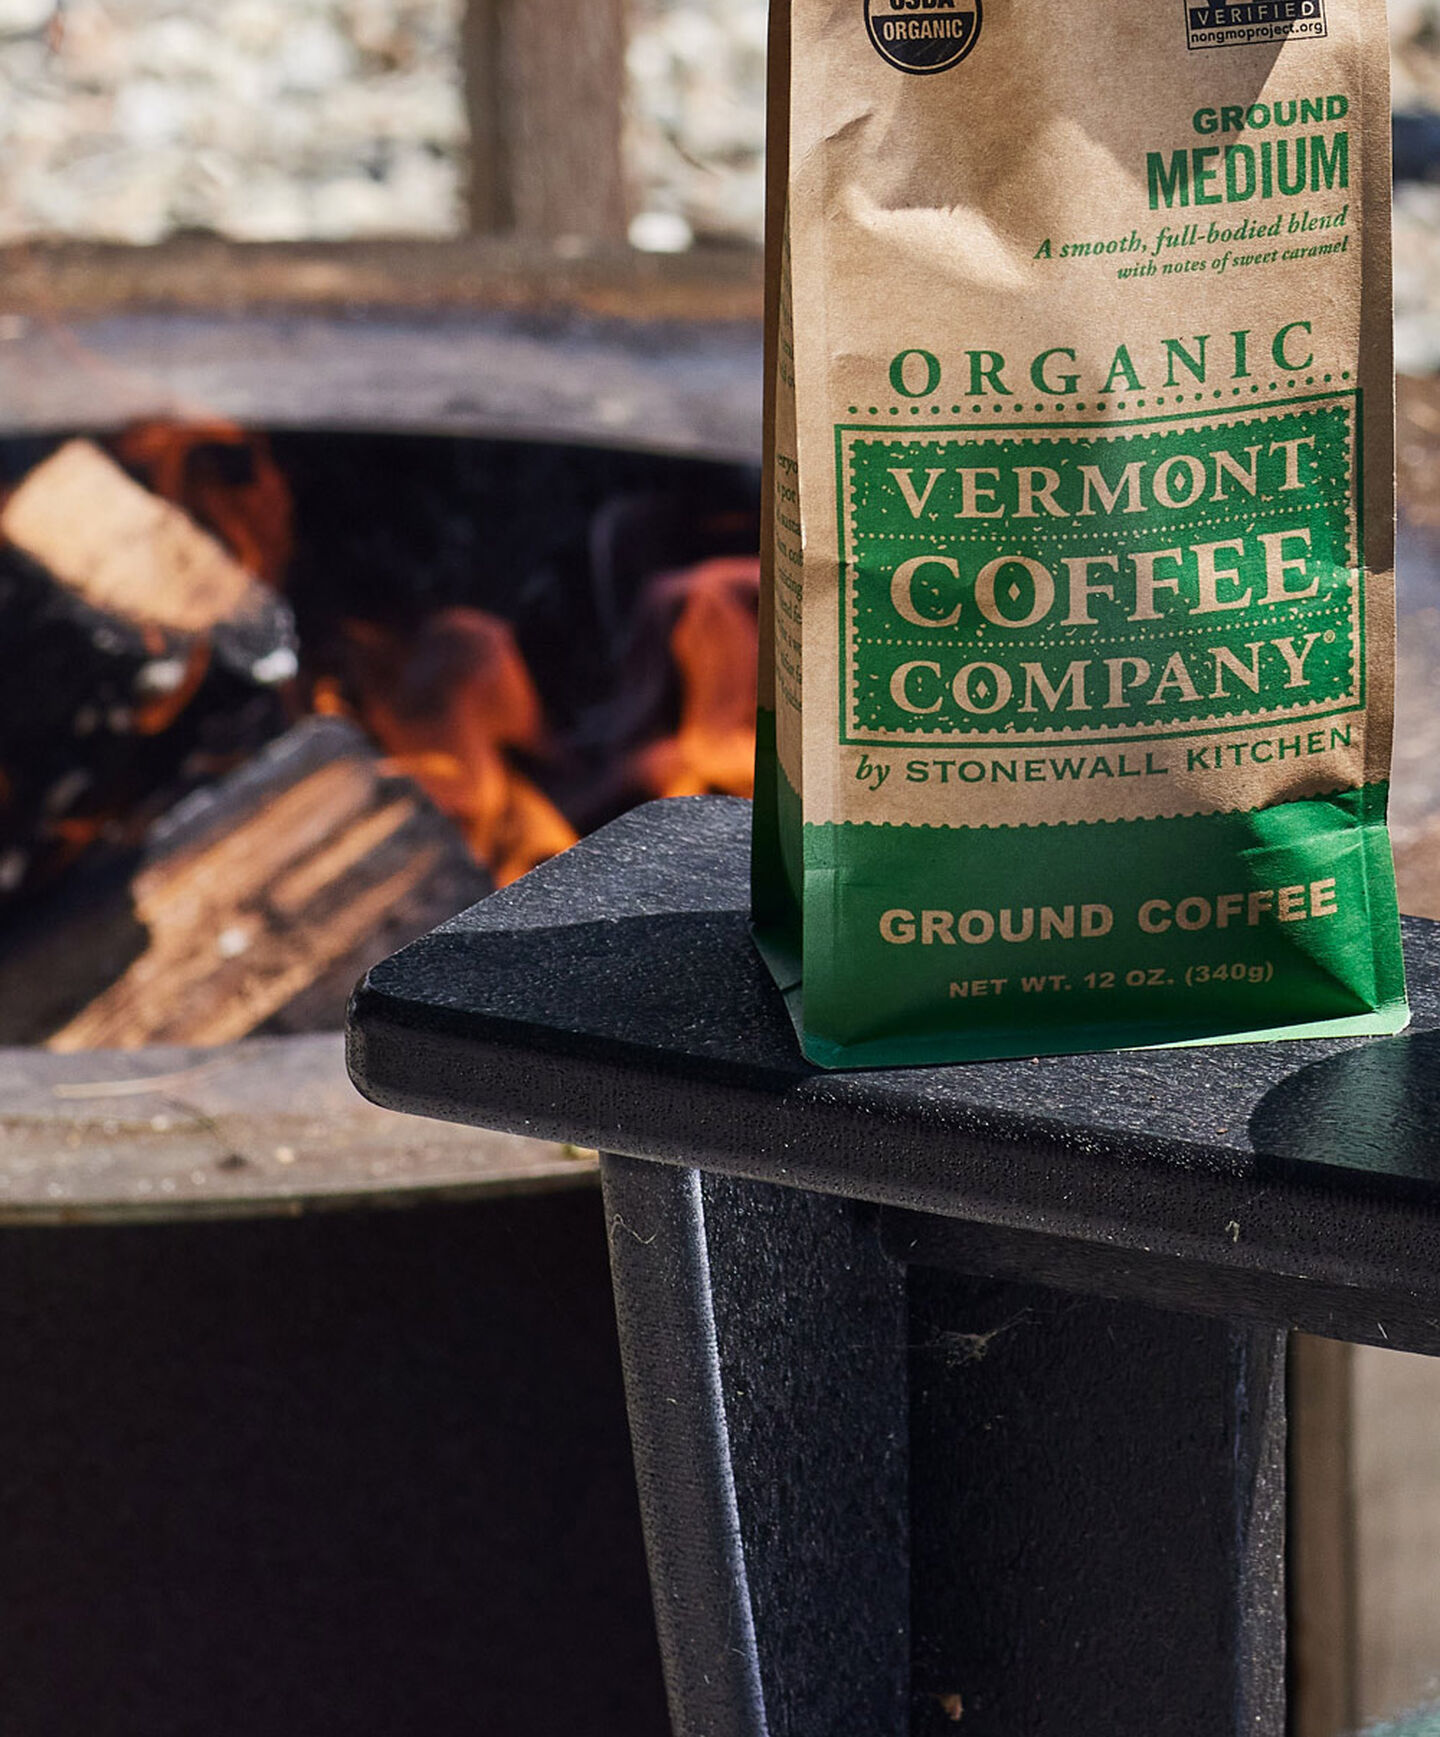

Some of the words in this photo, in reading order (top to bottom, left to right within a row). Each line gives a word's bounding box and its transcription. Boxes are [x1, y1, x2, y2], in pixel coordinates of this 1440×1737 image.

[882, 18, 964, 42] ORGANIC
[1190, 21, 1323, 44] nongmoproject.org
[1197, 0, 1315, 26] VERIFIED
[1192, 93, 1350, 135] GROUND
[1146, 131, 1350, 211] MEDIUM
[1032, 237, 1053, 260] A
[1059, 230, 1148, 259] smooth,
[1152, 216, 1281, 256] full-bodied
[1287, 204, 1350, 234] blend
[1117, 258, 1157, 279] with
[1162, 258, 1207, 276] notes
[1211, 251, 1232, 274] of
[1232, 250, 1278, 268] sweet
[1281, 235, 1349, 261] caramel
[888, 320, 1315, 399] ORGANIC
[886, 435, 1317, 520] VERMONT
[889, 526, 1321, 629] COFFEE
[855, 754, 891, 790] by
[905, 752, 1170, 784] STONEWALL
[1185, 724, 1352, 773] KITCHEN
[878, 903, 1114, 946] GROUND
[1137, 877, 1339, 936] COFFEE
[949, 978, 1008, 999] NET
[1020, 974, 1072, 995] WT.
[1083, 970, 1116, 990] 12
[1125, 967, 1175, 987] OZ.
[1185, 961, 1275, 988] (340g)
